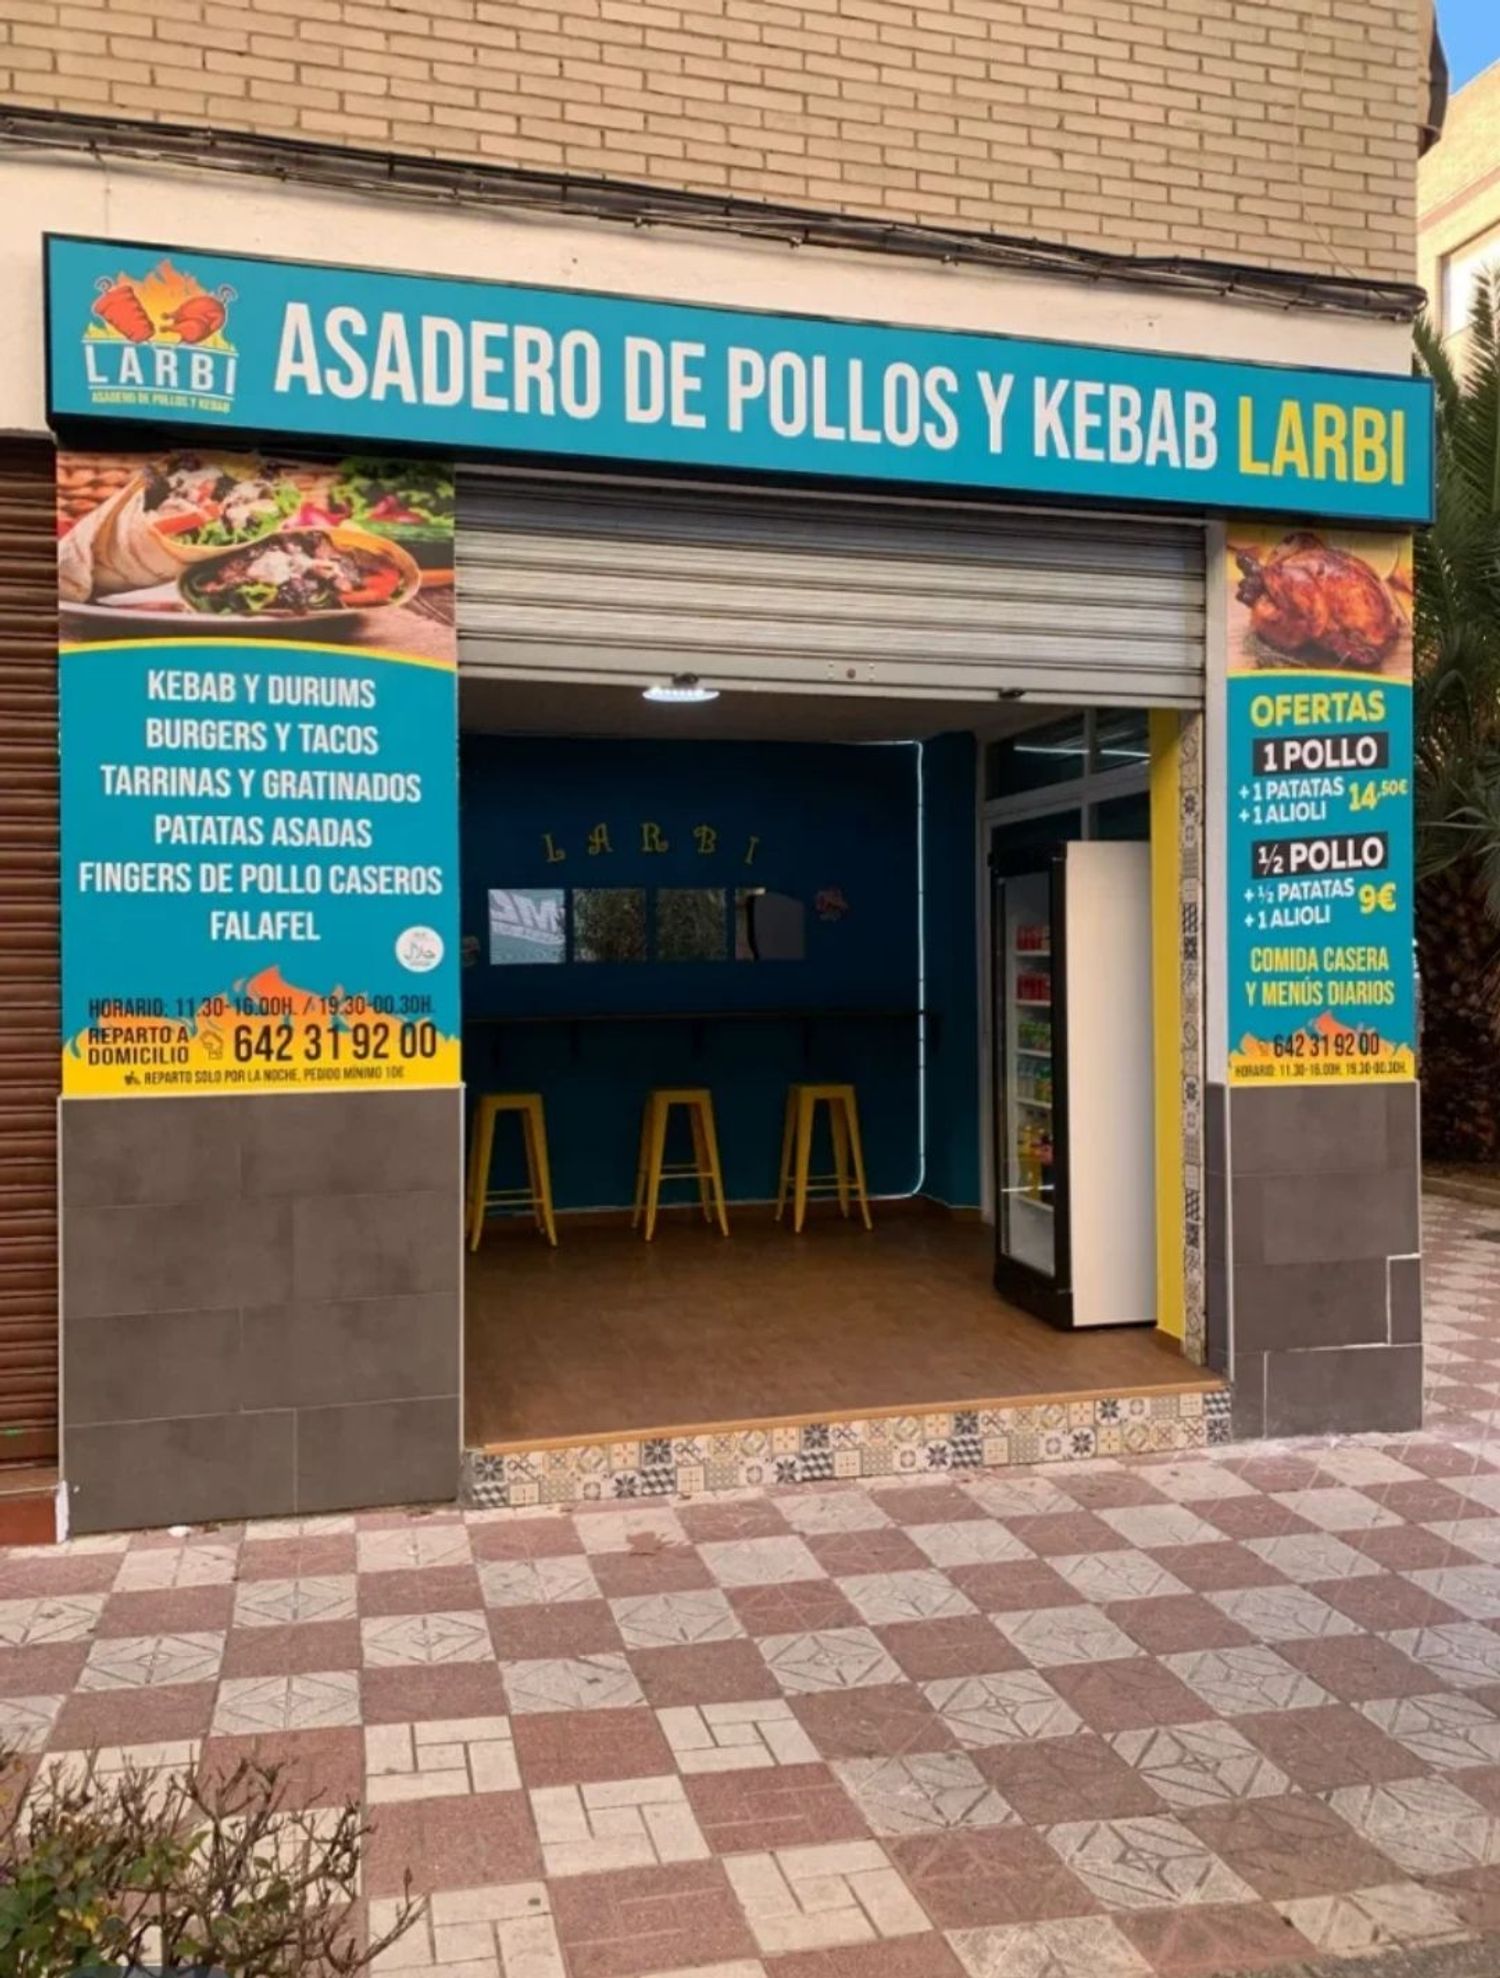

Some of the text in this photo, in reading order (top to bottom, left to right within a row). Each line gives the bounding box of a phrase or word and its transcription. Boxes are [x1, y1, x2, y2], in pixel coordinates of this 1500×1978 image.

[85, 344, 236, 395] LARBI
[274, 302, 1406, 485] ASADERO DE POLLOS Y KEBAB LARBI
[148, 670, 376, 708] KEBAB Y DURUMS
[1250, 690, 1385, 727] OFERTAS
[146, 718, 379, 755] BURGERS Y TACOS
[1264, 736, 1378, 771] 1 POLLO
[101, 765, 421, 803] TARRINAS Y GRATINADOS
[1253, 783, 1262, 801] 1
[1266, 777, 1344, 800] PATATAS
[1253, 806, 1262, 824] 1
[1265, 801, 1327, 823] ALIOLI
[155, 815, 372, 848] PATATAS ASADAS
[542, 823, 759, 864] LARBI
[1290, 837, 1384, 872] POLLO
[79, 862, 443, 895] FINGERS DE POLLO CASEROS
[1278, 878, 1355, 901] PATATAS
[1359, 883, 1396, 914] 9€
[211, 911, 321, 940] FALAFEL
[1258, 911, 1266, 929] 1
[1270, 905, 1330, 928] ALIOLI
[1251, 947, 1389, 972] COMIDA CASERA
[1245, 976, 1395, 1006] Y MENÚS DIARIOS
[88, 1026, 189, 1045] REPARTO A
[234, 1022, 437, 1062] 642 31 92 00
[1274, 1032, 1379, 1057] 642 31 92 00
[88, 1047, 188, 1065] DOMICILIO
[144, 1071, 192, 1084] REPARTO
[195, 1071, 222, 1083] SOLO
[225, 1070, 245, 1083] POR
[248, 1070, 261, 1081] LA
[304, 1068, 341, 1080] PEDIDO
